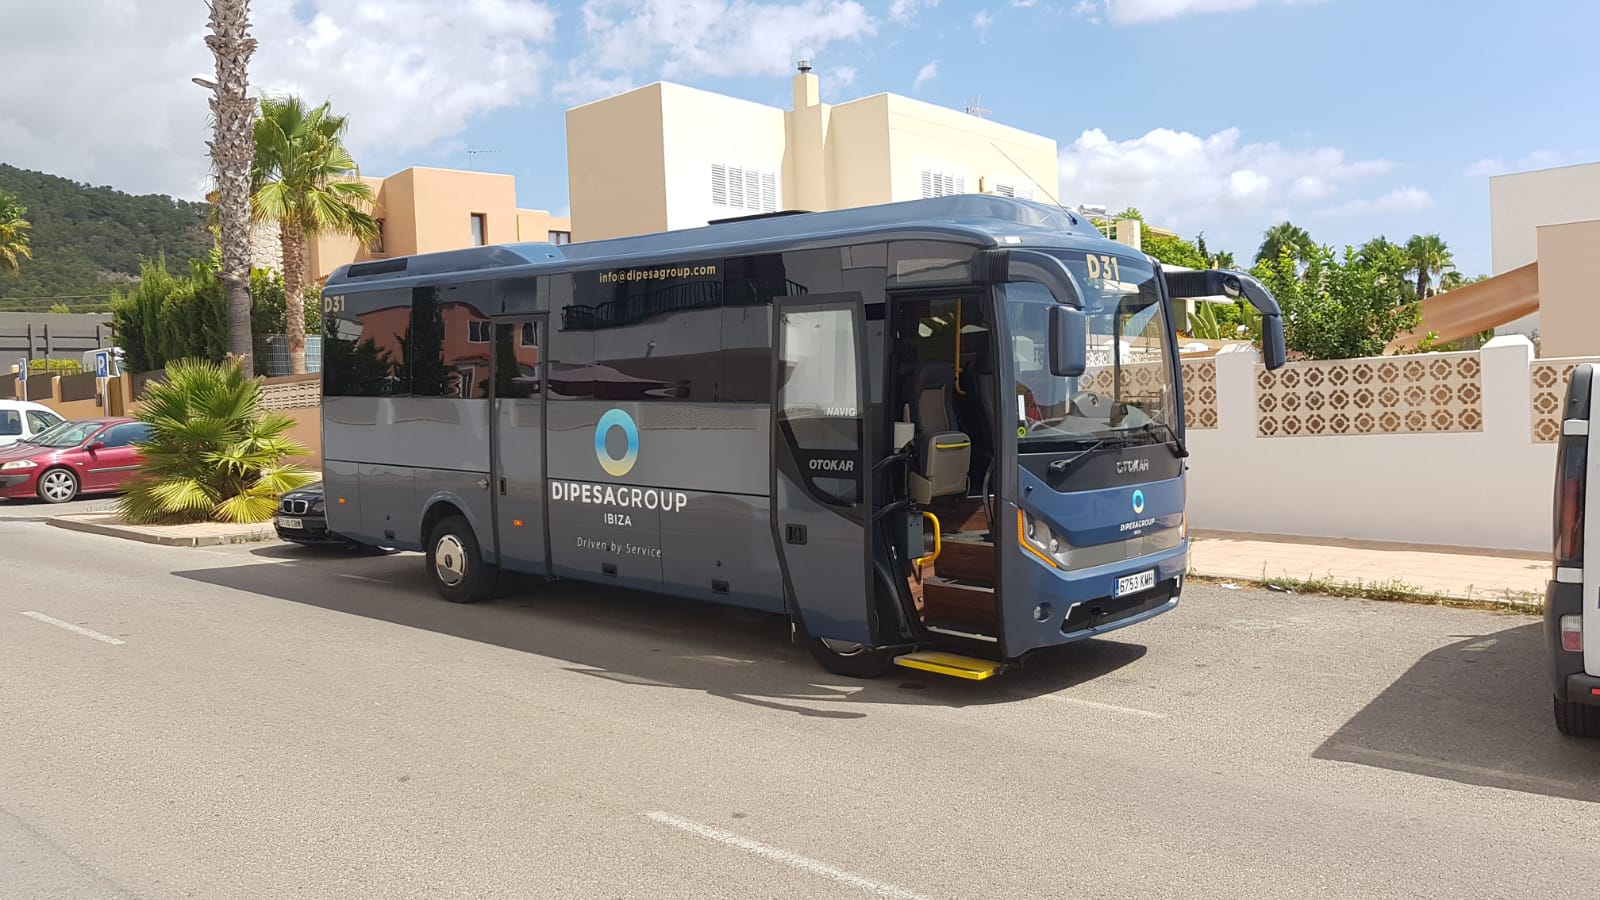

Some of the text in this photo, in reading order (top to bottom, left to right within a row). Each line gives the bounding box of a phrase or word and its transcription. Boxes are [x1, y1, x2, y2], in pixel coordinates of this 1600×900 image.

[599, 265, 716, 283] info@dipesagroup.com
[1086, 254, 1120, 281] D31
[324, 295, 345, 312] D31
[98, 355, 105, 375] P
[826, 407, 857, 417] NAVIG
[809, 459, 854, 472] OTOKAR
[1116, 459, 1149, 474] OTOKAR
[552, 482, 687, 512] DIPESAGROUP
[604, 513, 632, 527] IBIZA
[1120, 517, 1155, 532] DIPESAGROUP
[577, 536, 662, 558] Driven by Service
[1120, 576, 1138, 593] 6753
